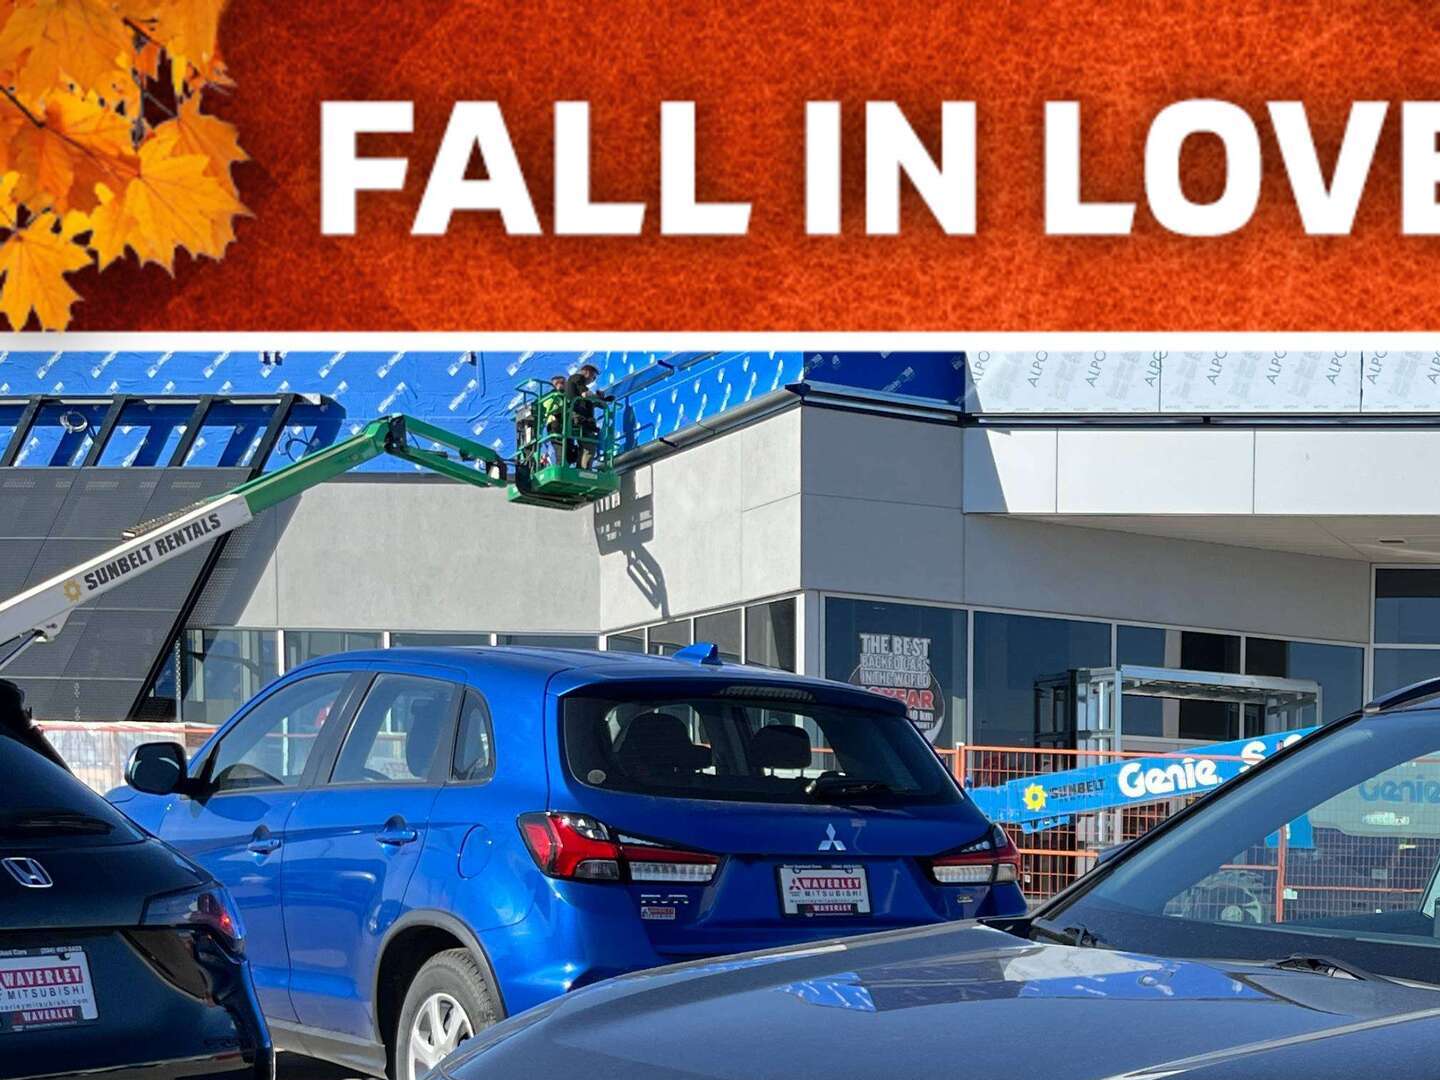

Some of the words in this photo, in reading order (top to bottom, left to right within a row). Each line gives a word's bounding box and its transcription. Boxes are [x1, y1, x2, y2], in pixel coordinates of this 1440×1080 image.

[84, 545, 154, 590] SUNBELT
[154, 513, 221, 556] RENTALS
[860, 633, 889, 655] THE
[892, 635, 932, 659] BEST
[1118, 757, 1218, 798] Genie
[801, 878, 860, 889] WAVERLEY
[2, 967, 80, 987] WAVERLEY
[7, 986, 86, 1000] MITSUBISHI
[22, 1007, 74, 1022] WAVERLEY
